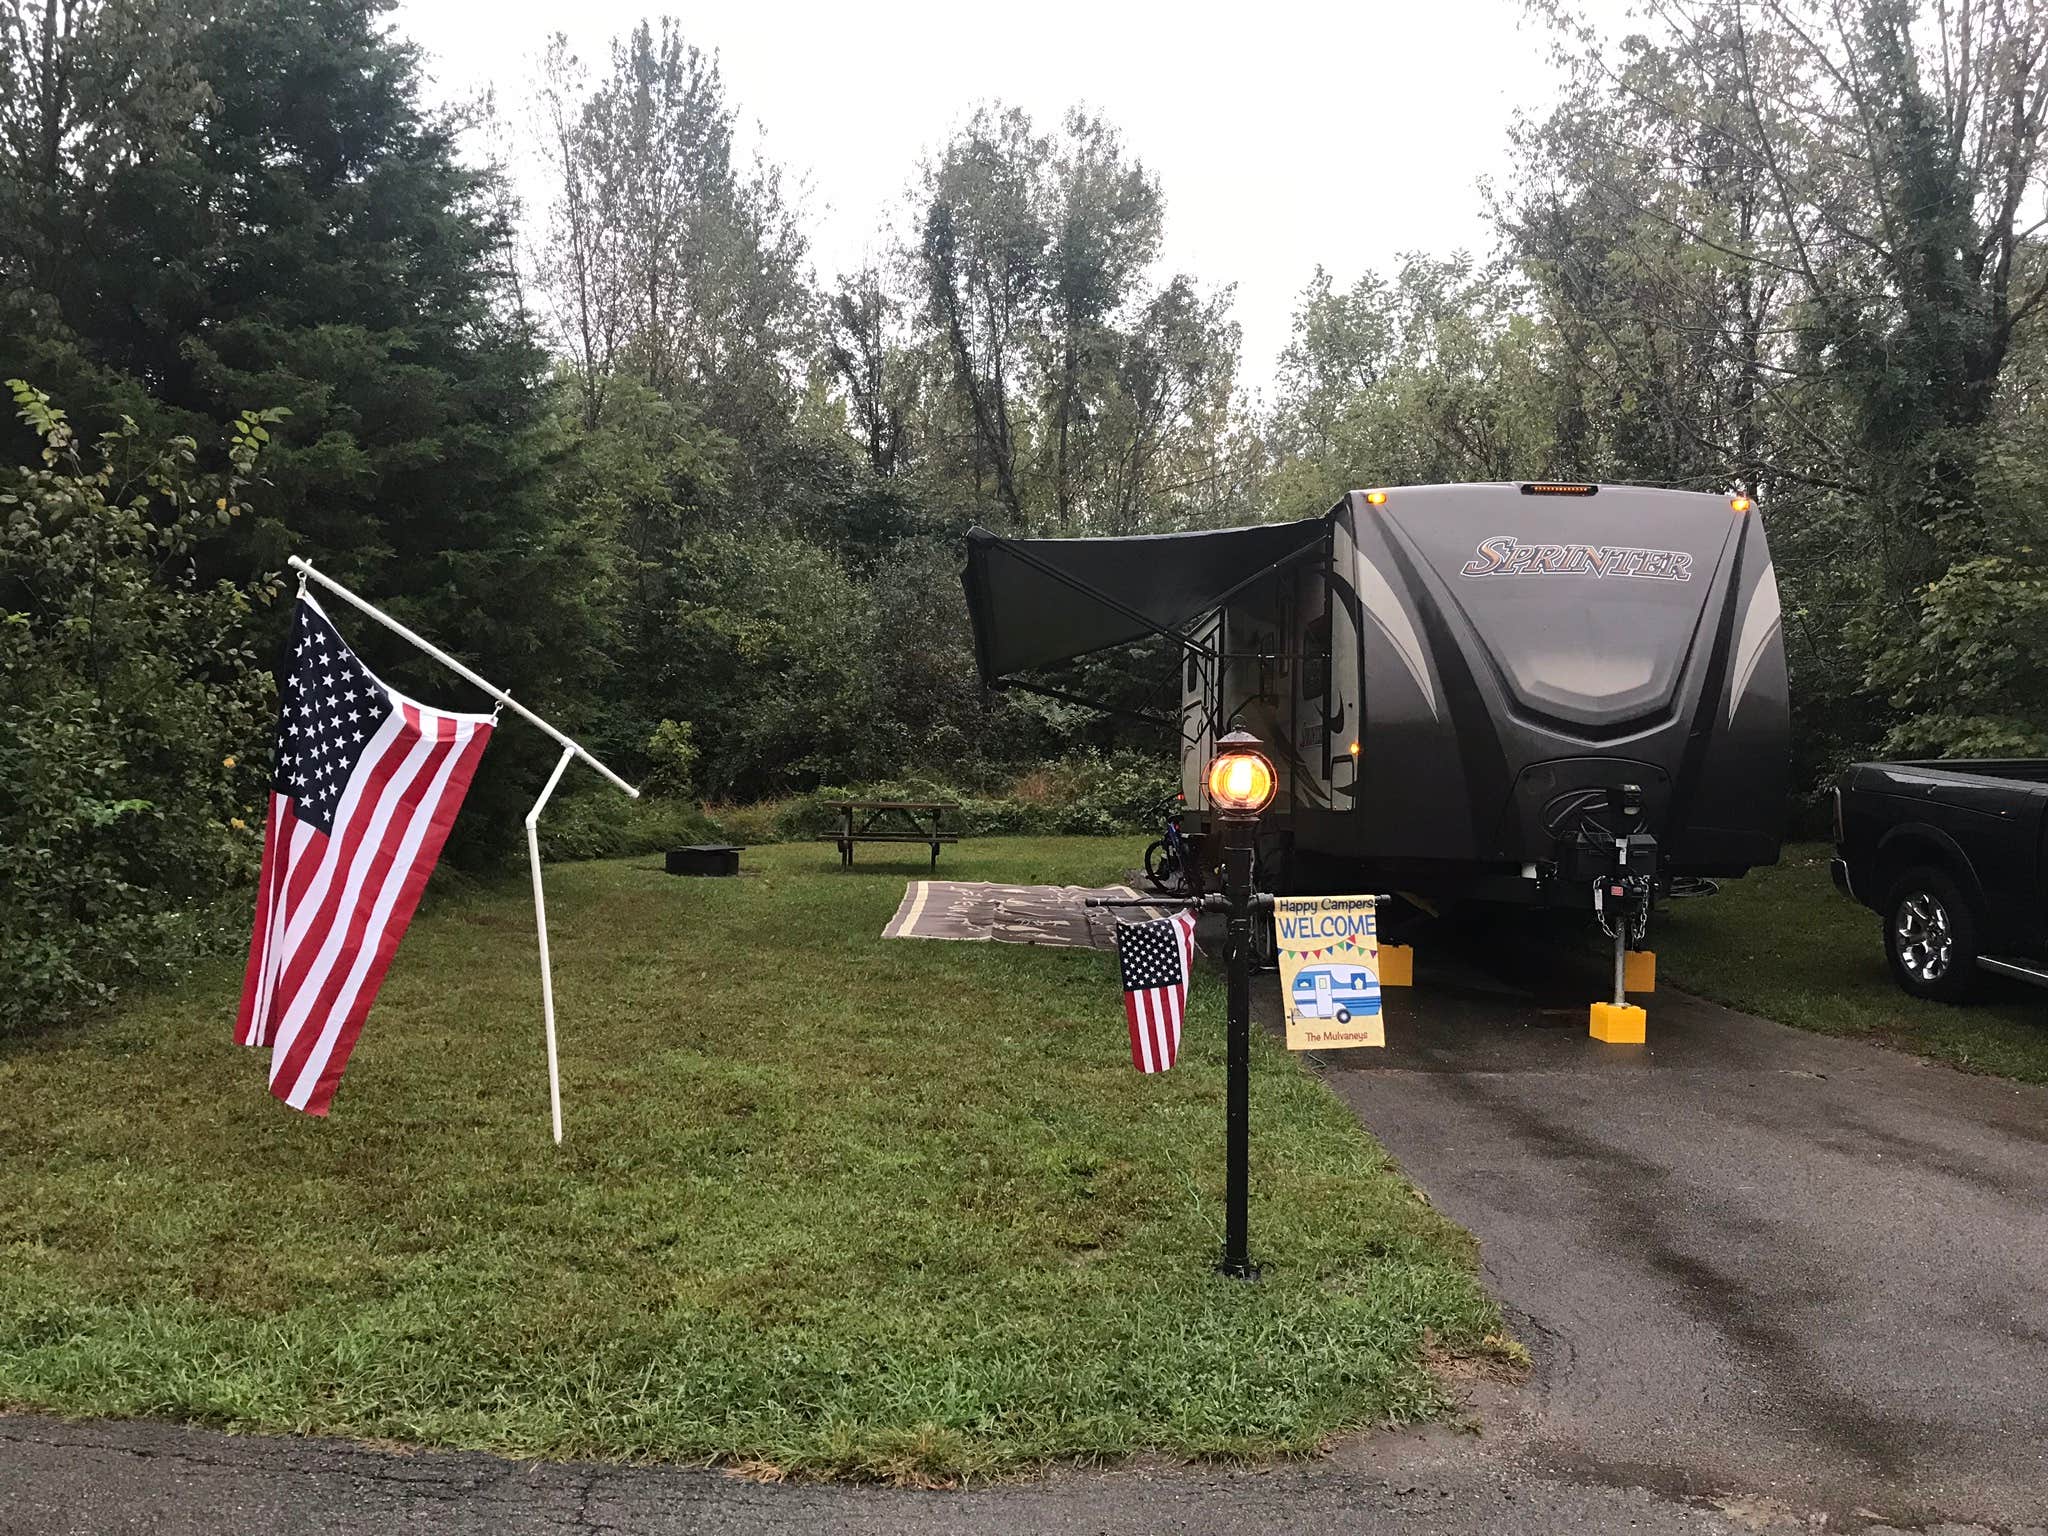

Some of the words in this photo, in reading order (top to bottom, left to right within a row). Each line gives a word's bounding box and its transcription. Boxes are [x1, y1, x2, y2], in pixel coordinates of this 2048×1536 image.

[1460, 536, 1693, 581] SPRINTER
[1279, 899, 1317, 915] Happy
[1321, 898, 1374, 913] Campers
[1278, 915, 1377, 938] WELCOME
[1306, 1031, 1321, 1042] The
[1323, 1031, 1368, 1043] Mulvaneys
